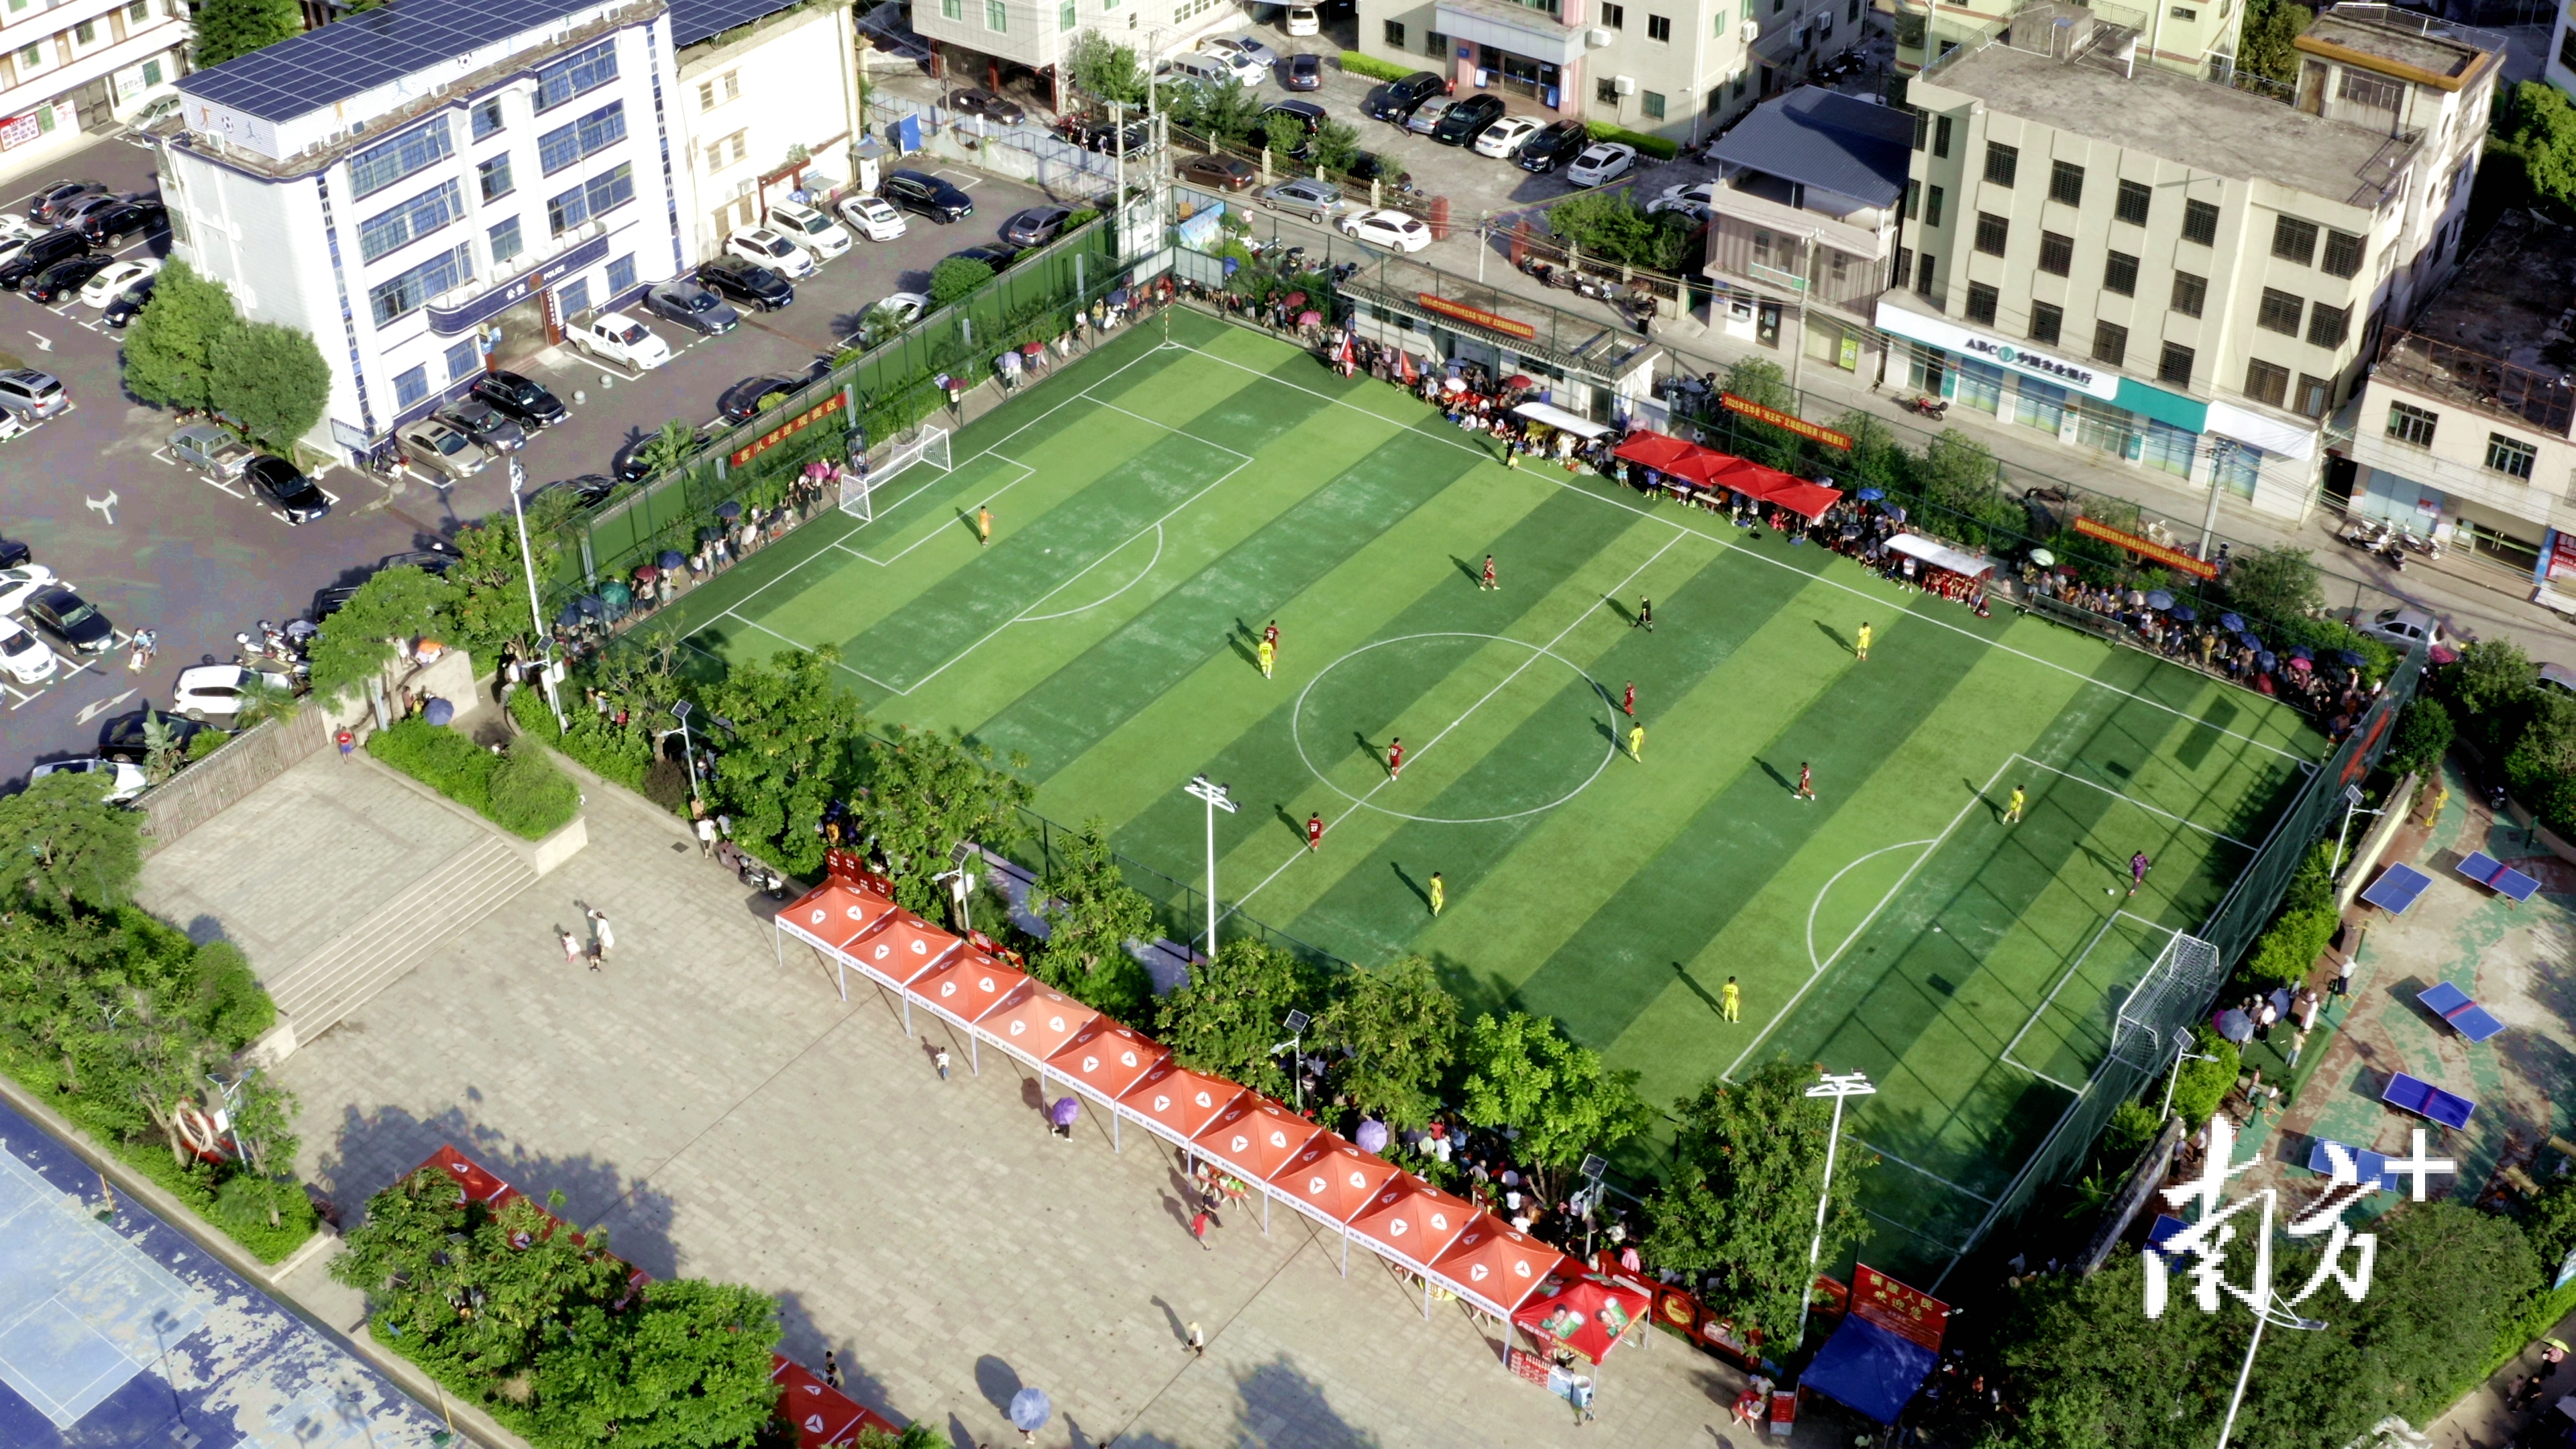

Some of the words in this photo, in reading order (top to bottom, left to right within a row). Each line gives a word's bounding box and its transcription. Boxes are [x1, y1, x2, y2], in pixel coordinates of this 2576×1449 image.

[543, 264, 566, 280] POLICE
[506, 283, 525, 300] 公安
[1965, 338, 1998, 356] ABC
[2017, 352, 2092, 385] 中国农业银行
[1873, 1290, 1923, 1322] 欢迎您
